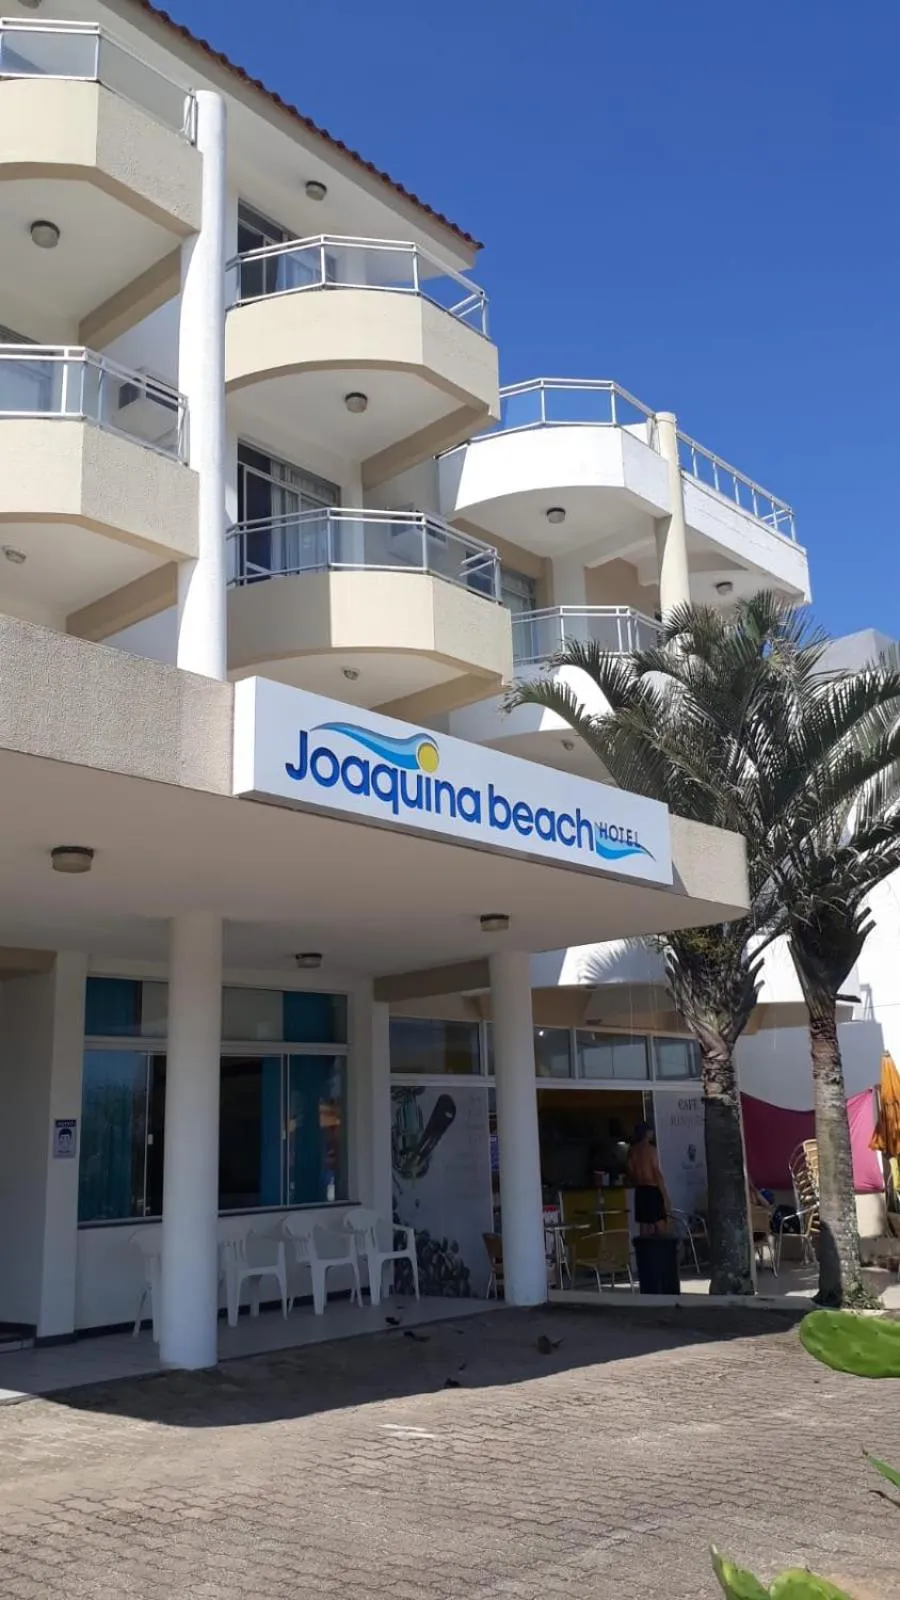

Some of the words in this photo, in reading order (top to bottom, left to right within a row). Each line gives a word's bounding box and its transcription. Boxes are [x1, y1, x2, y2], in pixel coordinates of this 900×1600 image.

[285, 729, 482, 825] Joaquina
[488, 783, 594, 851] beach
[600, 821, 641, 848] HOTEL
